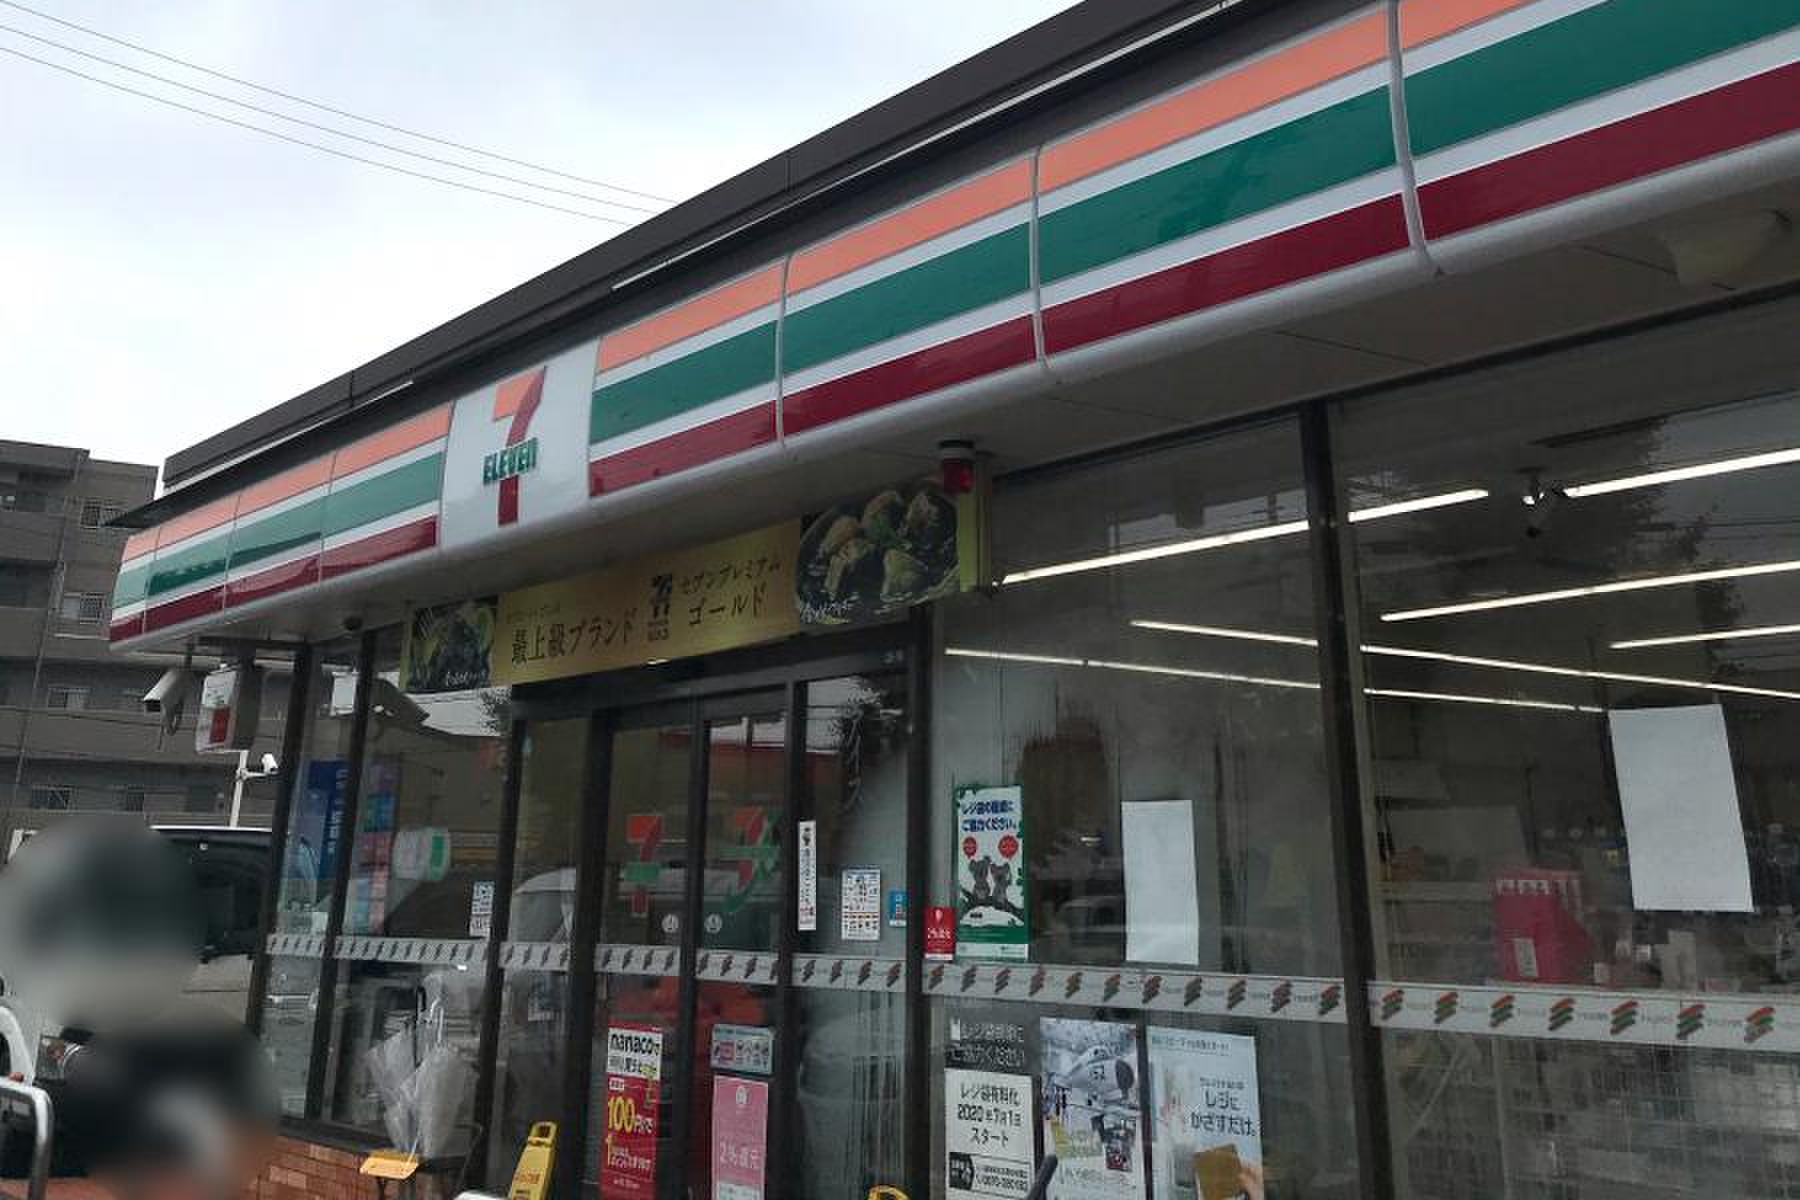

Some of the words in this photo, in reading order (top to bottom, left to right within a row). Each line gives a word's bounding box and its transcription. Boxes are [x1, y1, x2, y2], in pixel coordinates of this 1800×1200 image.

[688, 582, 767, 628] ゴールド
[511, 607, 638, 665] 最上級ブランド
[1205, 1090, 1240, 1111] レジに
[1191, 1111, 1256, 1137] かざすだけ。
[971, 1128, 1008, 1147] スタート
